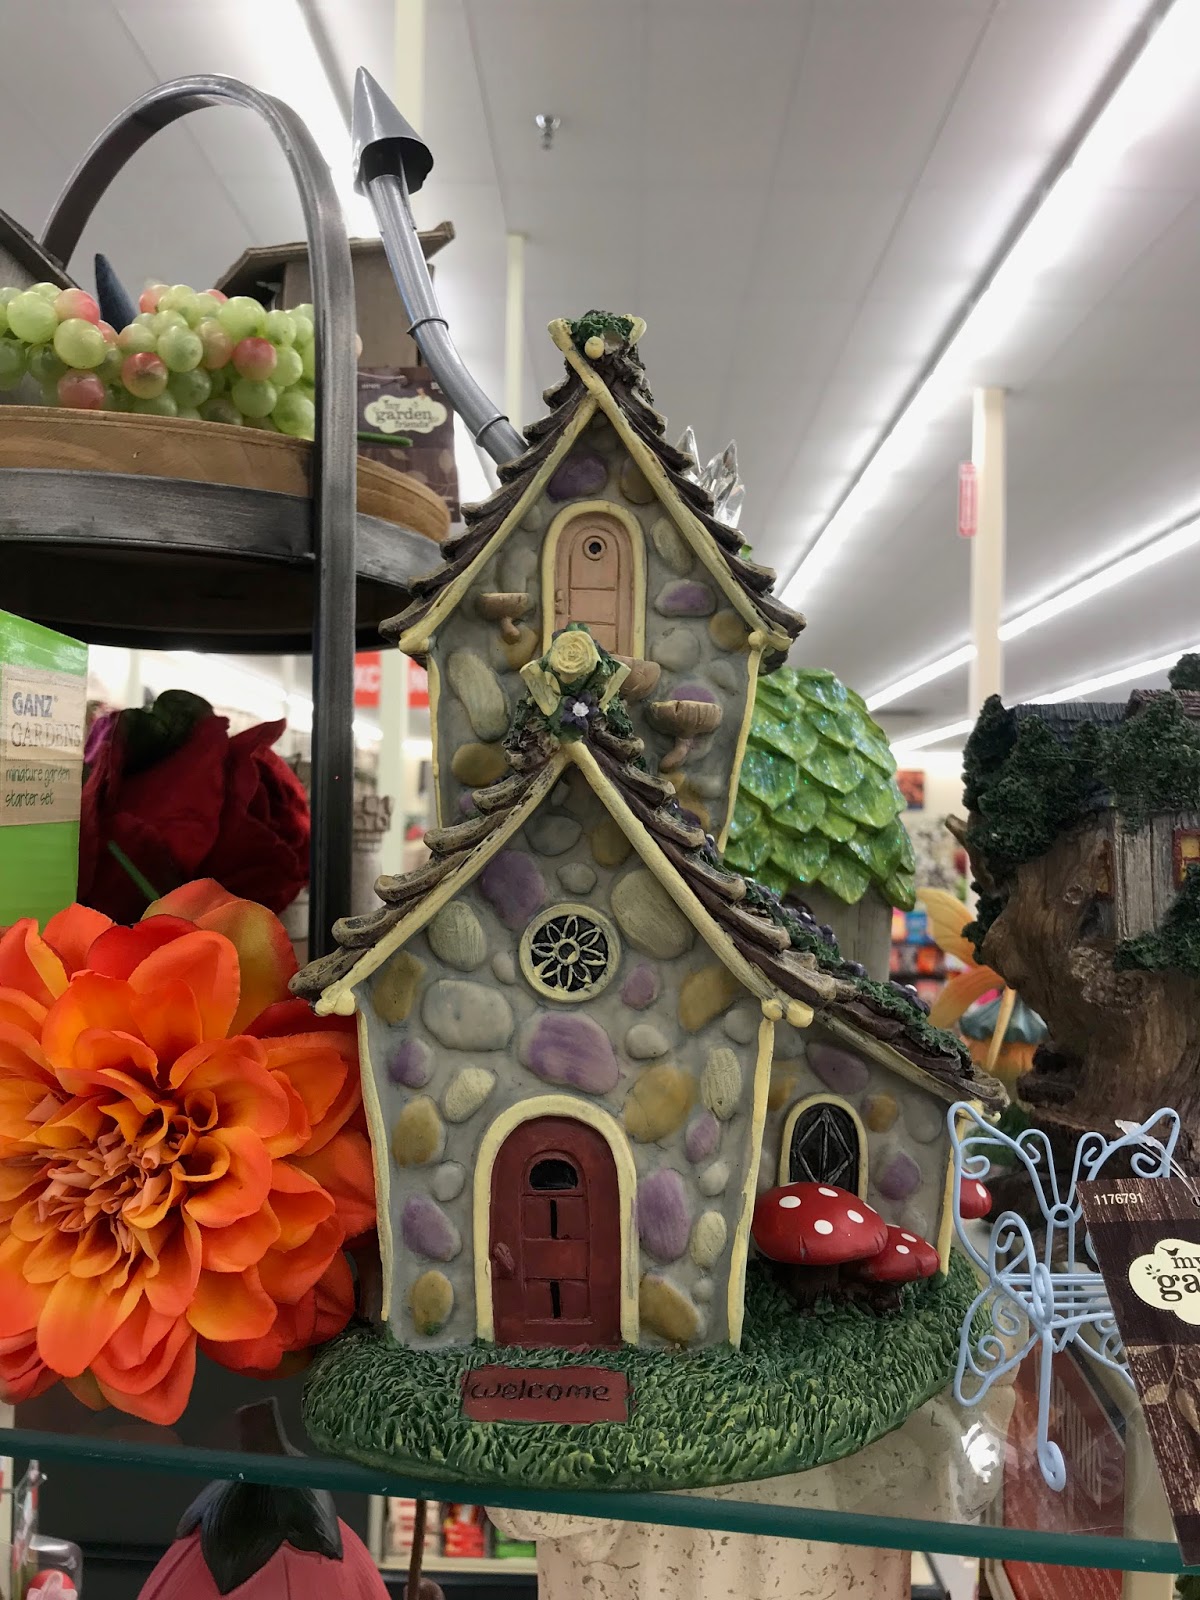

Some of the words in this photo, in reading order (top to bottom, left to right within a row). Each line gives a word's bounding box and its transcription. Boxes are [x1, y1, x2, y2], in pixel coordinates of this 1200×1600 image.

[375, 407, 432, 423] garden
[12, 691, 53, 718] GANZ
[11, 722, 81, 748] GARDENS
[6, 764, 43, 782] miniature
[5, 789, 39, 807] starter
[40, 788, 55, 806] set
[1094, 1192, 1144, 1206] 1176791
[470, 1379, 611, 1402] welcome
